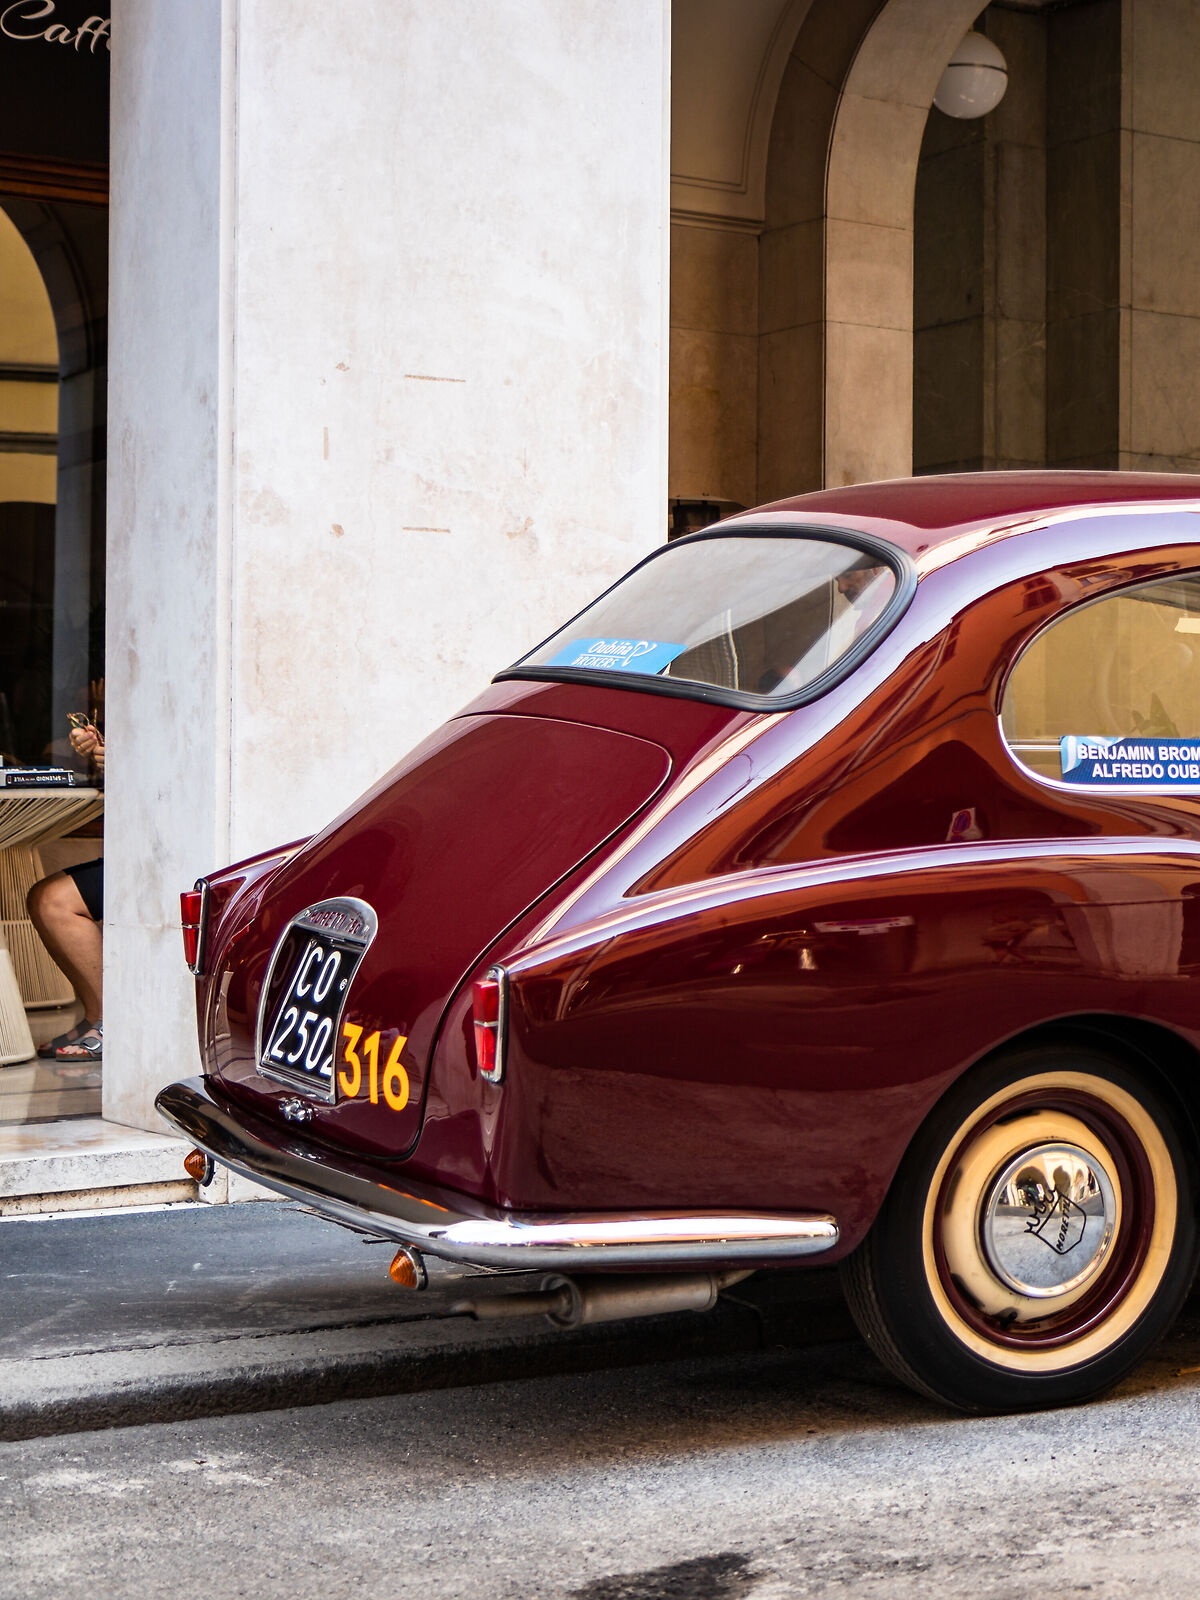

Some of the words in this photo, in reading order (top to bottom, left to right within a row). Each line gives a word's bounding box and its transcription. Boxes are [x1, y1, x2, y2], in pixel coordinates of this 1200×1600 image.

[0, 0, 111, 54] Caff
[571, 656, 620, 668] BROKERS
[587, 640, 634, 656] Oubiña
[1077, 745, 1156, 761] BENJAMIN
[1091, 763, 1165, 779] ALFREDO
[296, 946, 342, 1003] CO
[339, 1022, 410, 1111] 316
[1056, 1200, 1071, 1251] MORETTI
